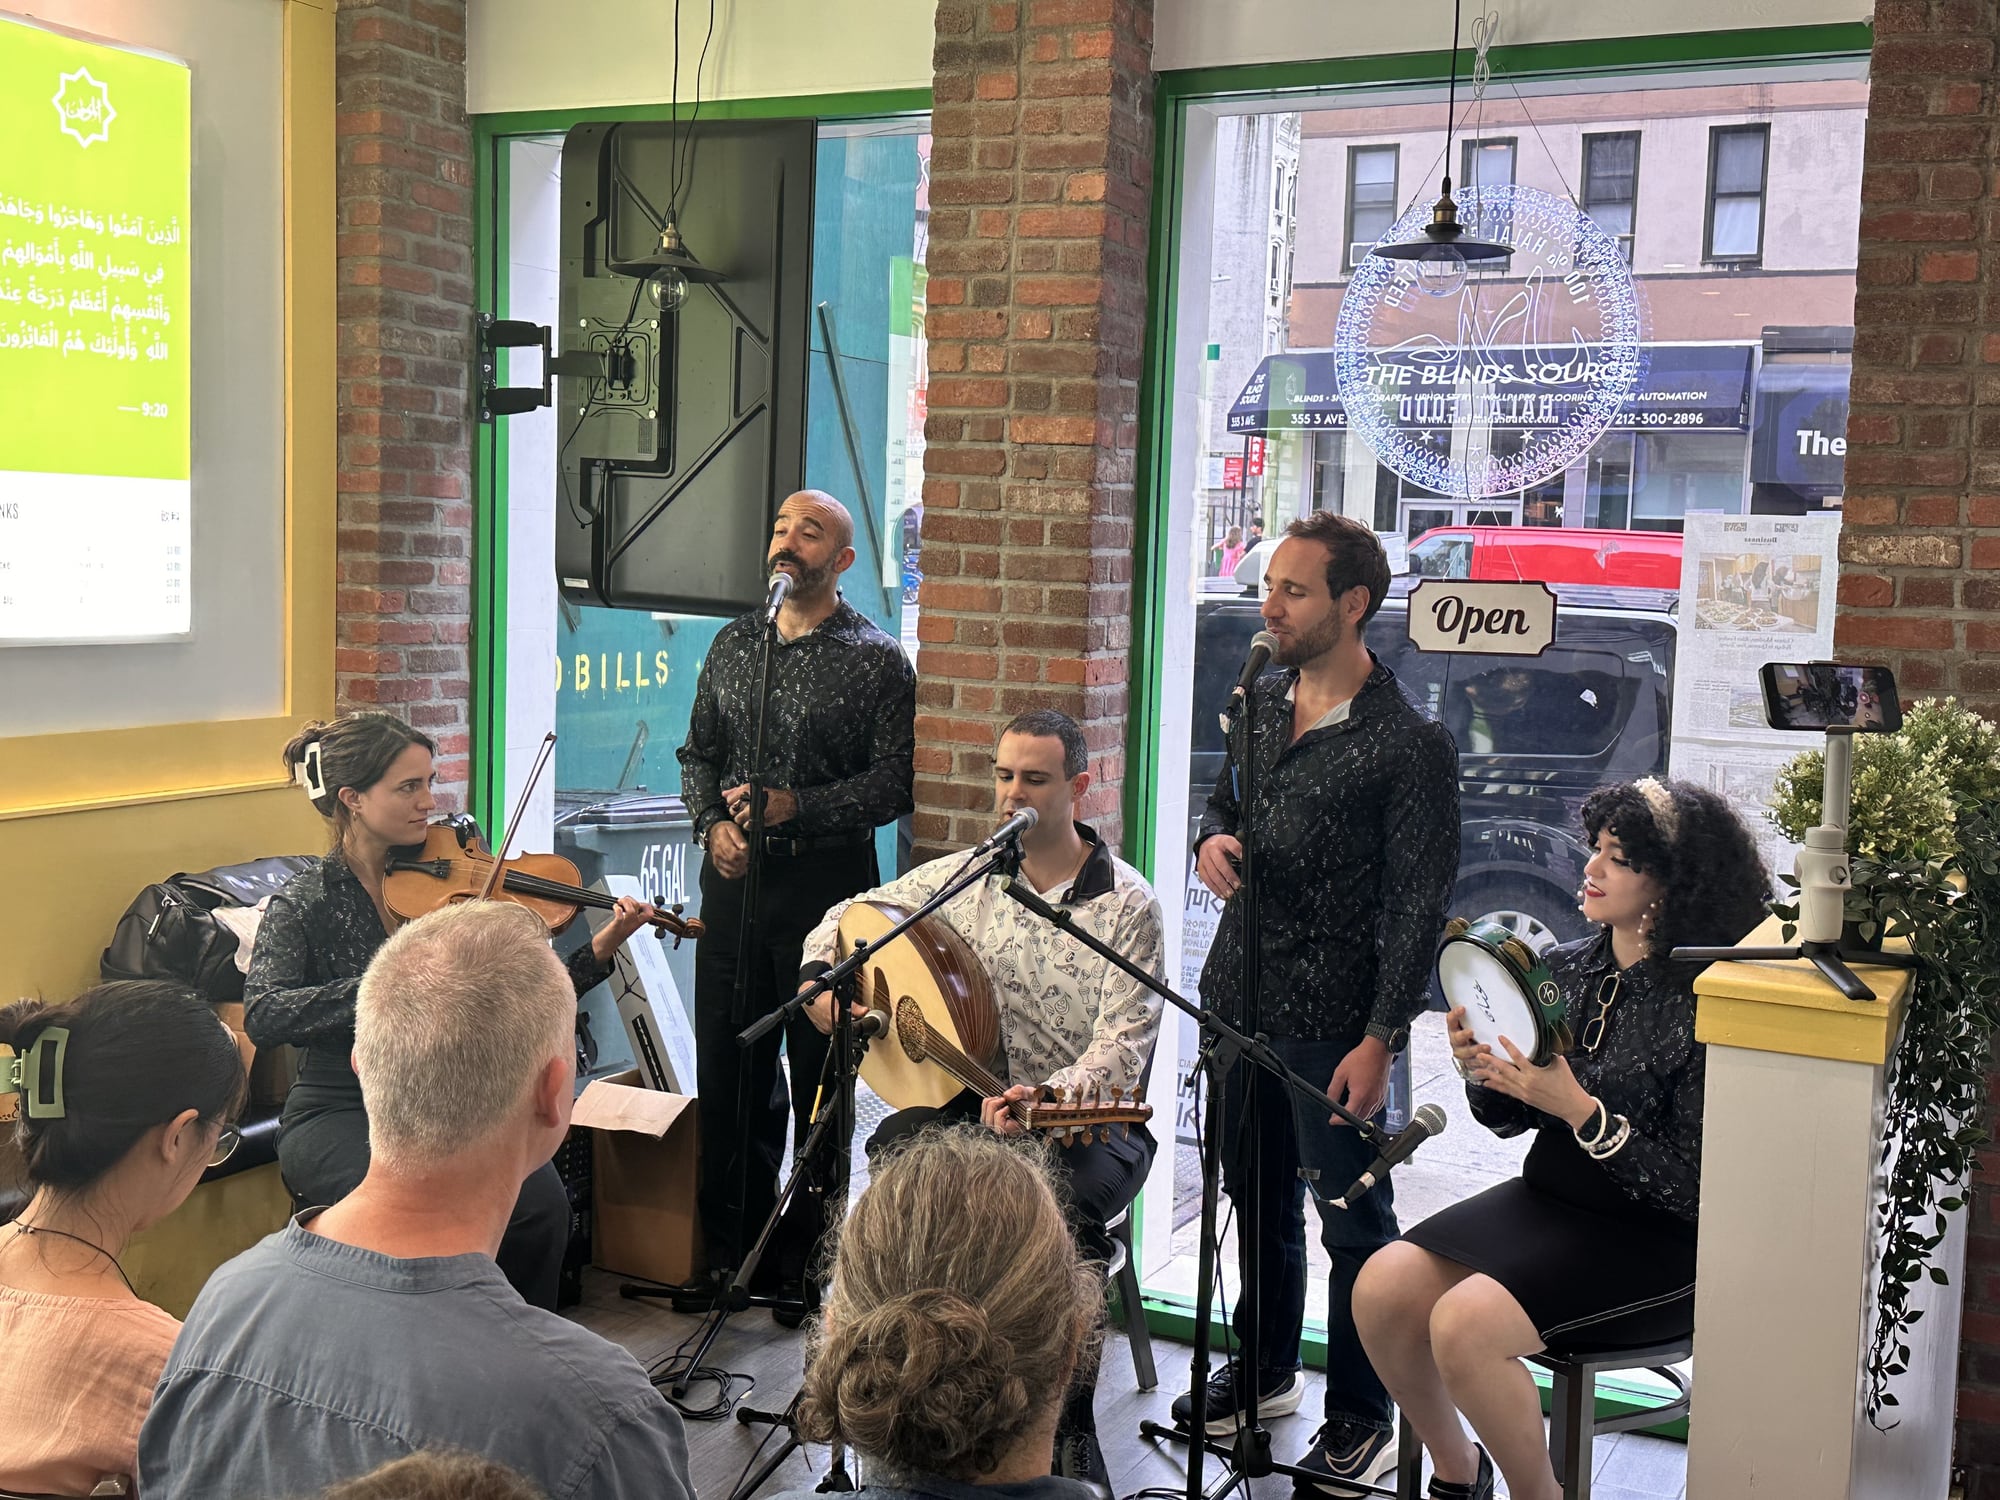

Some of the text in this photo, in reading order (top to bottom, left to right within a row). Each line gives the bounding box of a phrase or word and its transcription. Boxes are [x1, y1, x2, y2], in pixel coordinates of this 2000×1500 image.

[1367, 365, 1415, 385] THE
[1421, 364, 1515, 385] BLINDS
[1293, 394, 1324, 403] BLINDS
[1637, 391, 1708, 402] AUTOMATION
[1290, 414, 1311, 425] 355
[1314, 414, 1321, 425] 3
[1324, 413, 1348, 425] AVE.
[1615, 412, 1704, 425] 212-300-2896
[1797, 430, 1848, 456] The
[1431, 595, 1530, 644] Open
[575, 650, 669, 692] BILLS
[639, 842, 691, 905] 65 GAL
